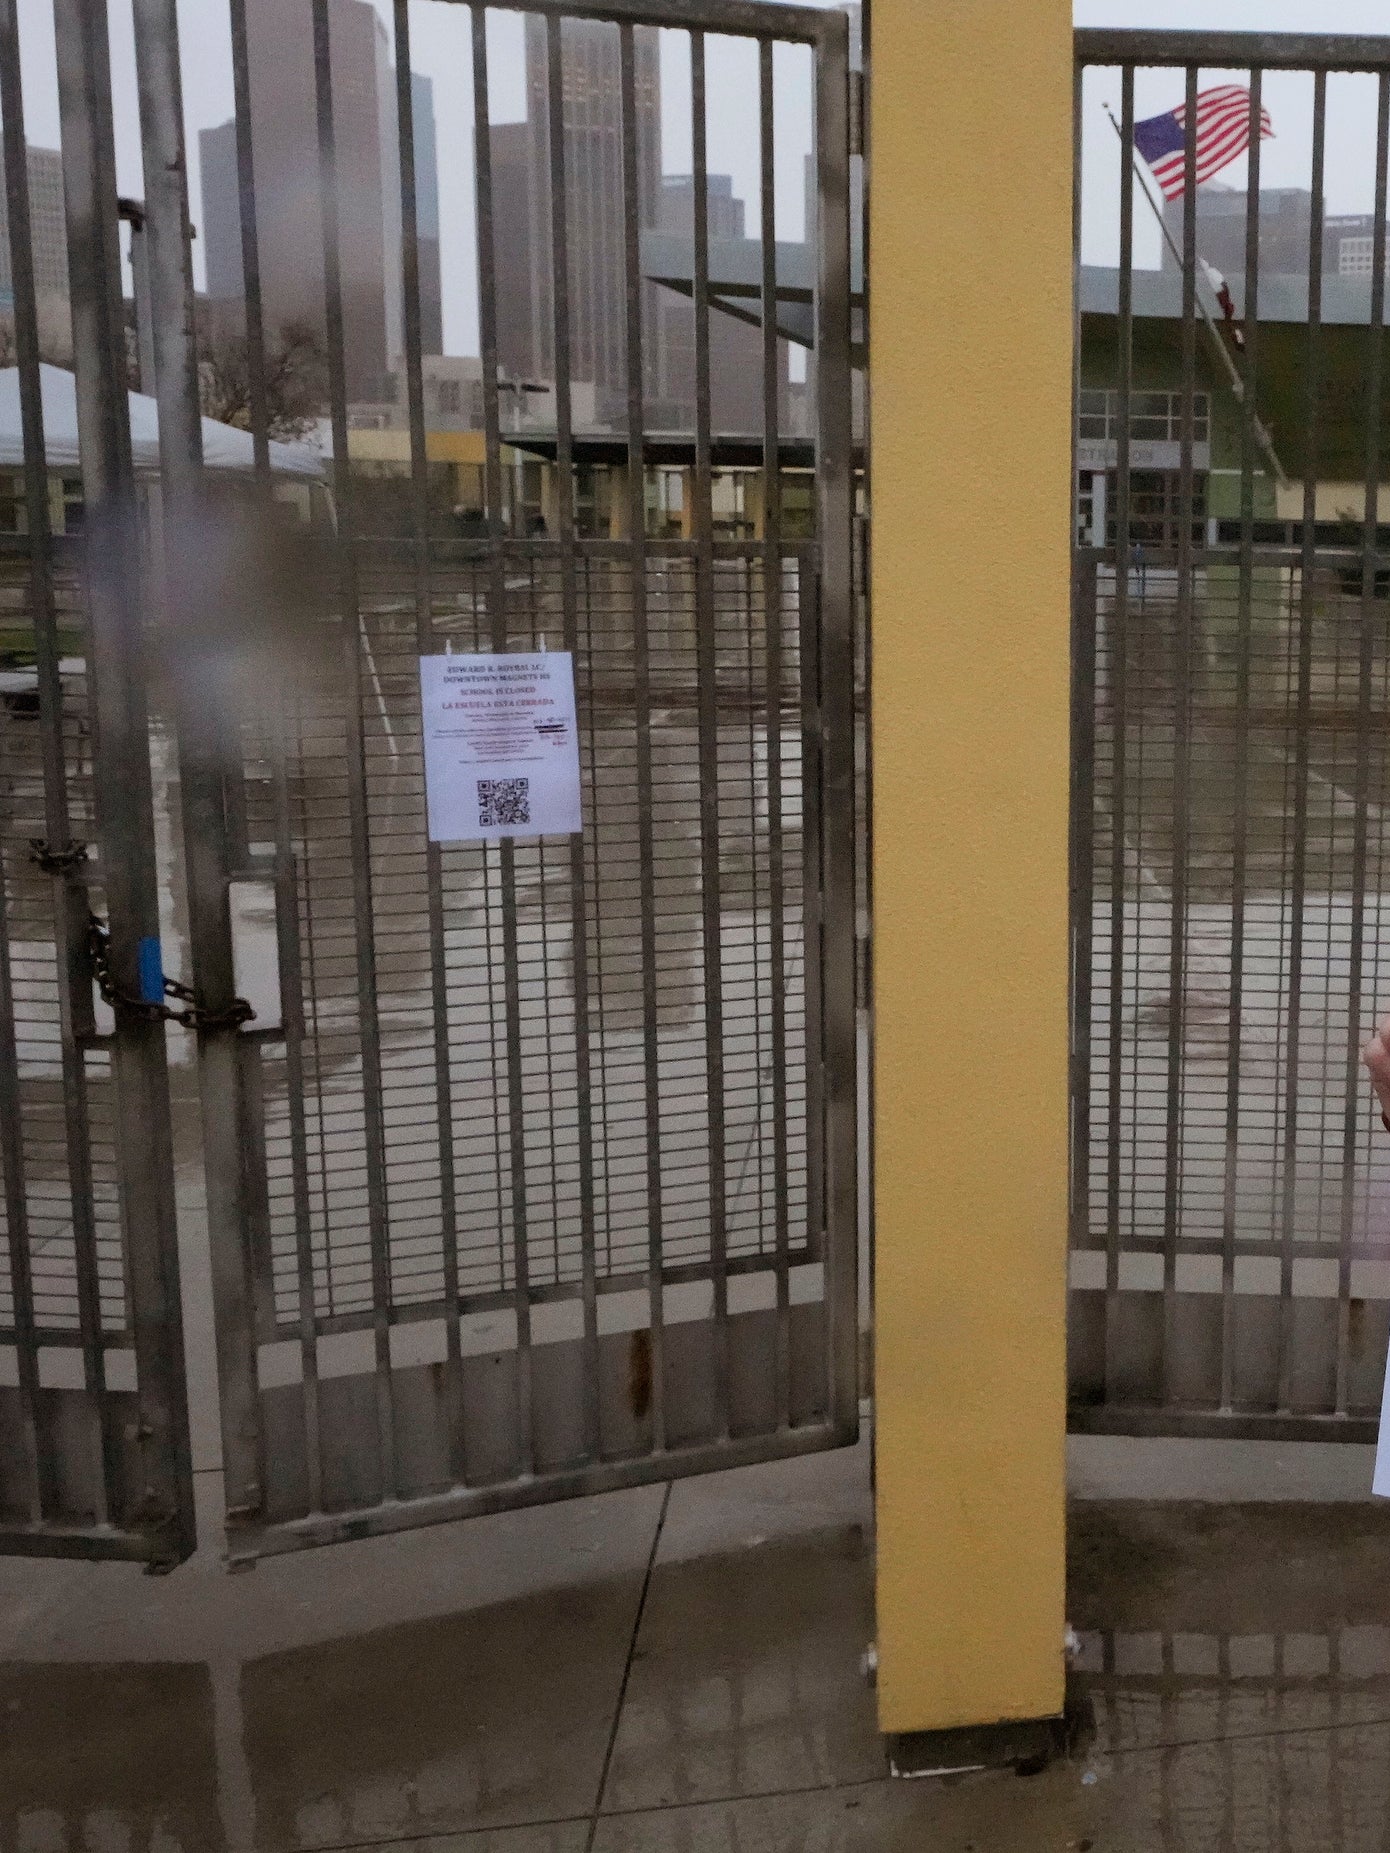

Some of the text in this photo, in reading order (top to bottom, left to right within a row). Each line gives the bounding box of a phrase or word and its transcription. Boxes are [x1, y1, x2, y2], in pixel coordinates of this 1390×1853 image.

[447, 665, 486, 673] EDWARD
[443, 675, 500, 683] DOWNTOWN
[500, 673, 538, 681] MAGNETS
[460, 688, 494, 696] SCHOOL
[505, 686, 536, 694] CLOSED
[454, 700, 491, 709] ESCUELA
[516, 698, 554, 706] CERRADA
